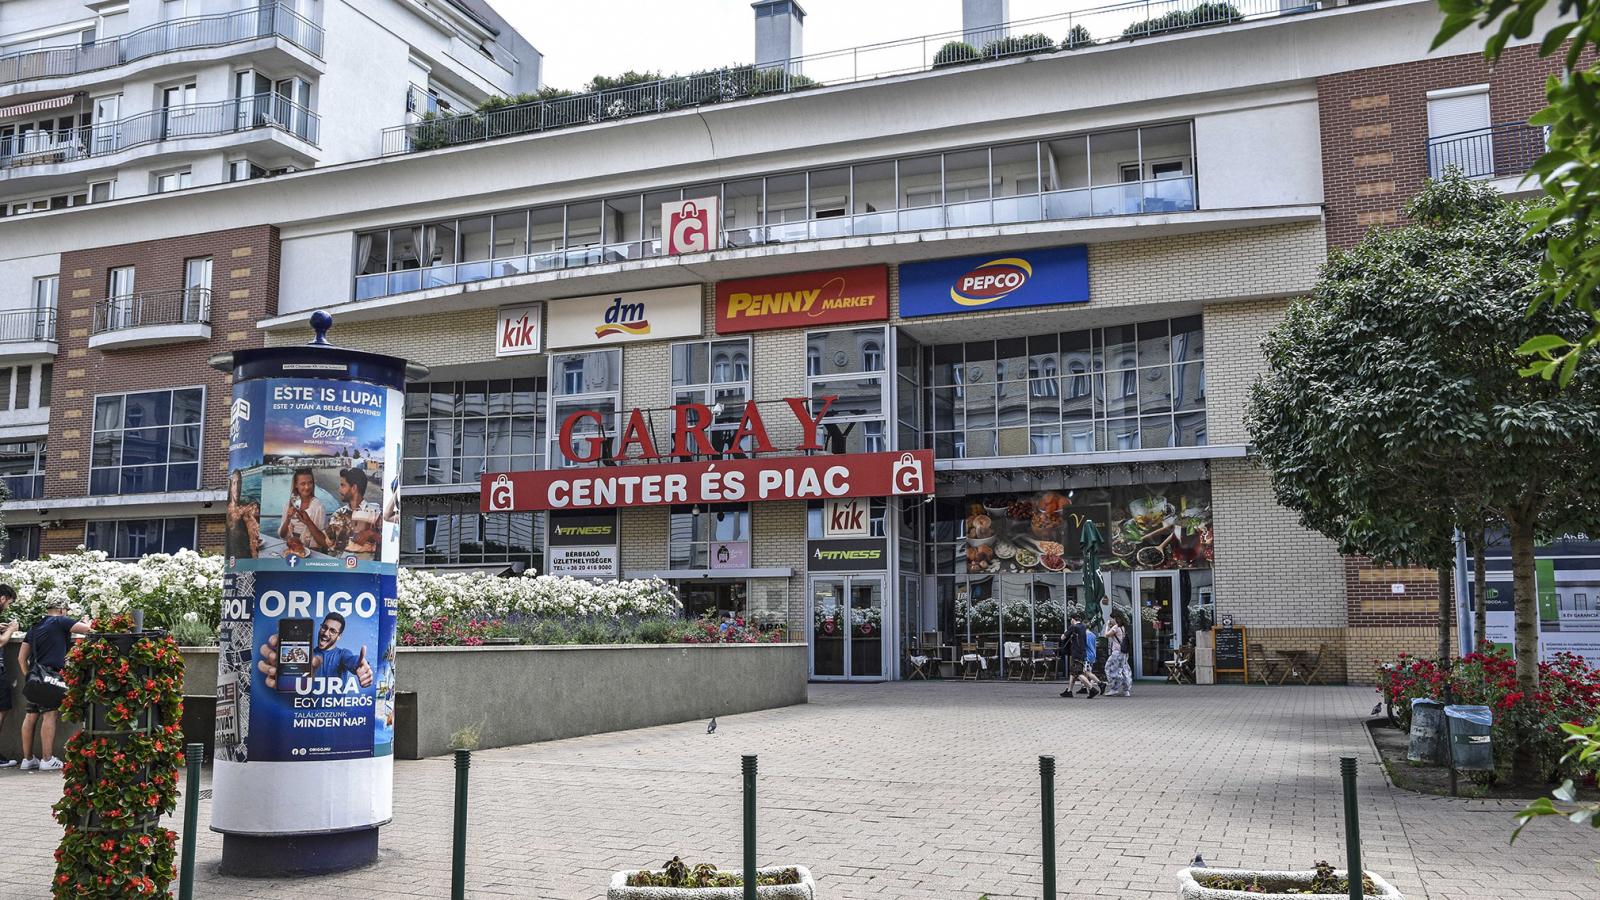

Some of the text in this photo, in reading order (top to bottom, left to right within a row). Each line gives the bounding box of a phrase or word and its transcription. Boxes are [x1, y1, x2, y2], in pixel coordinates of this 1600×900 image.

[962, 272, 1019, 291] PEPCO
[604, 297, 644, 324] dm
[726, 288, 875, 319] PENNY MARKET
[502, 312, 534, 349] kik
[274, 387, 382, 408] ESTE IS LUPA!
[323, 405, 351, 413] BELÉPÉS
[305, 415, 354, 431] LUPA
[558, 394, 838, 463] GARAY
[312, 427, 345, 440] Beach
[547, 463, 850, 508] CENTER ÉS PIAC
[831, 497, 864, 531] kik
[553, 557, 613, 565] ÜZLETHELYISÉGEK
[565, 550, 600, 558] BÉRBEADÓ
[259, 590, 377, 618] ORIGO
[295, 672, 360, 696] ÚJRA
[294, 694, 373, 709] EGY ISMERŐS
[293, 717, 367, 728] MINDEN NAP!
[294, 710, 347, 719] TALÁLKOZZUNK
